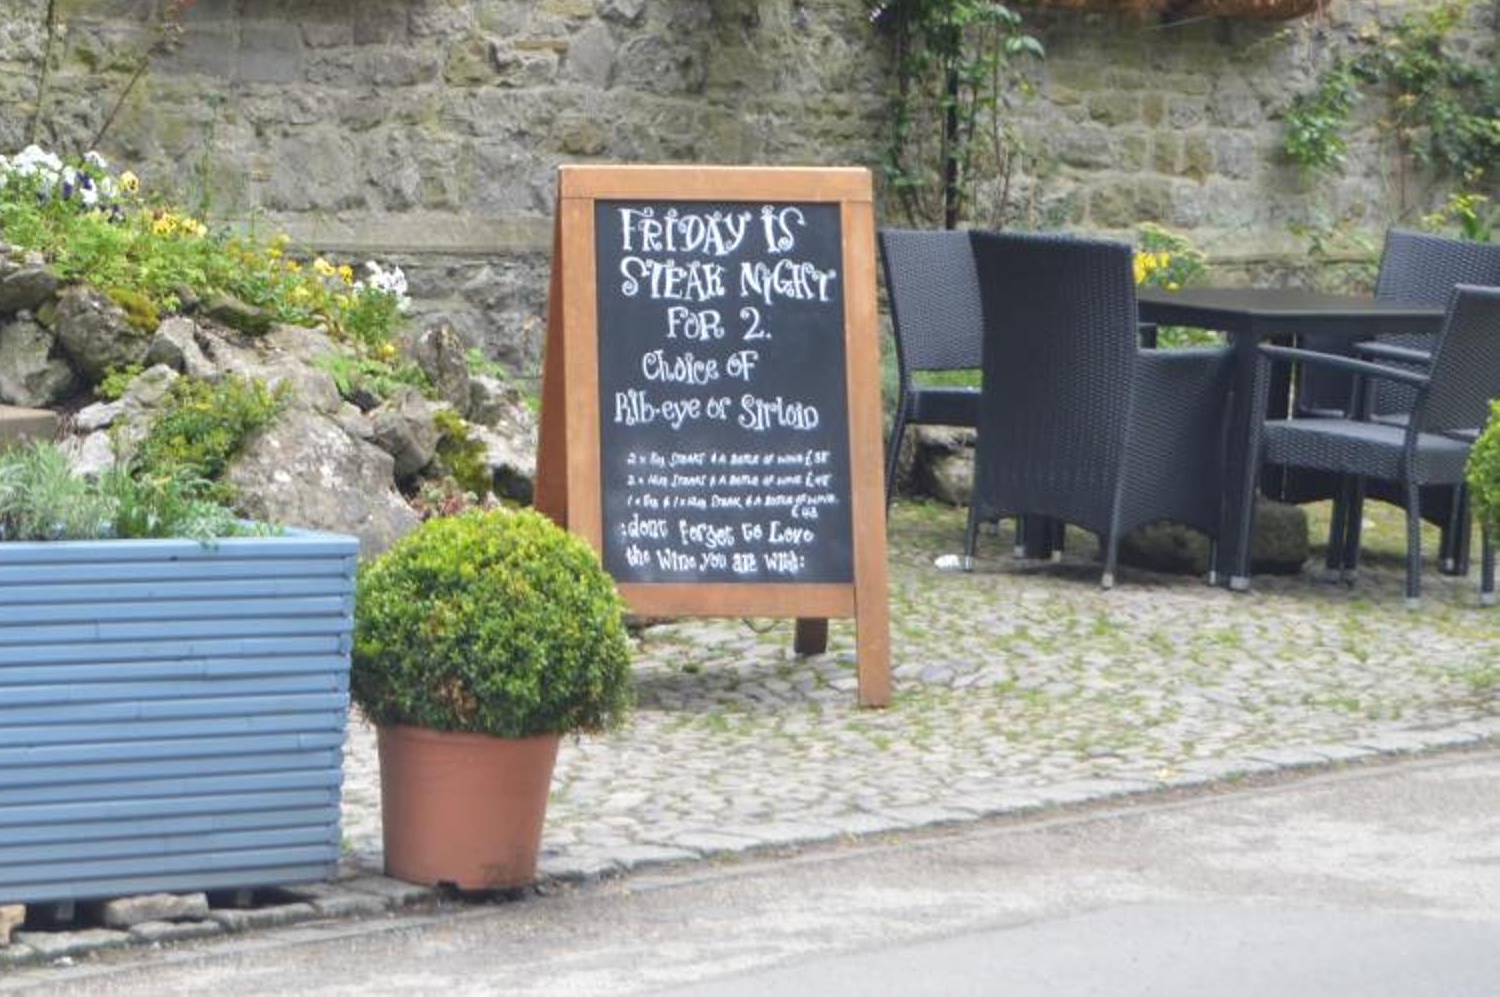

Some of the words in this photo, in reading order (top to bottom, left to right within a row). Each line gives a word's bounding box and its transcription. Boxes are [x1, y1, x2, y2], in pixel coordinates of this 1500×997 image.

[618, 207, 752, 256] FRIDAY
[761, 205, 805, 253] IS
[621, 257, 725, 301] STEAK
[667, 306, 725, 340] FOR
[740, 307, 772, 340] 2.
[643, 349, 719, 385] Choice
[706, 397, 731, 420] or
[741, 523, 763, 542] to
[699, 551, 728, 572] you
